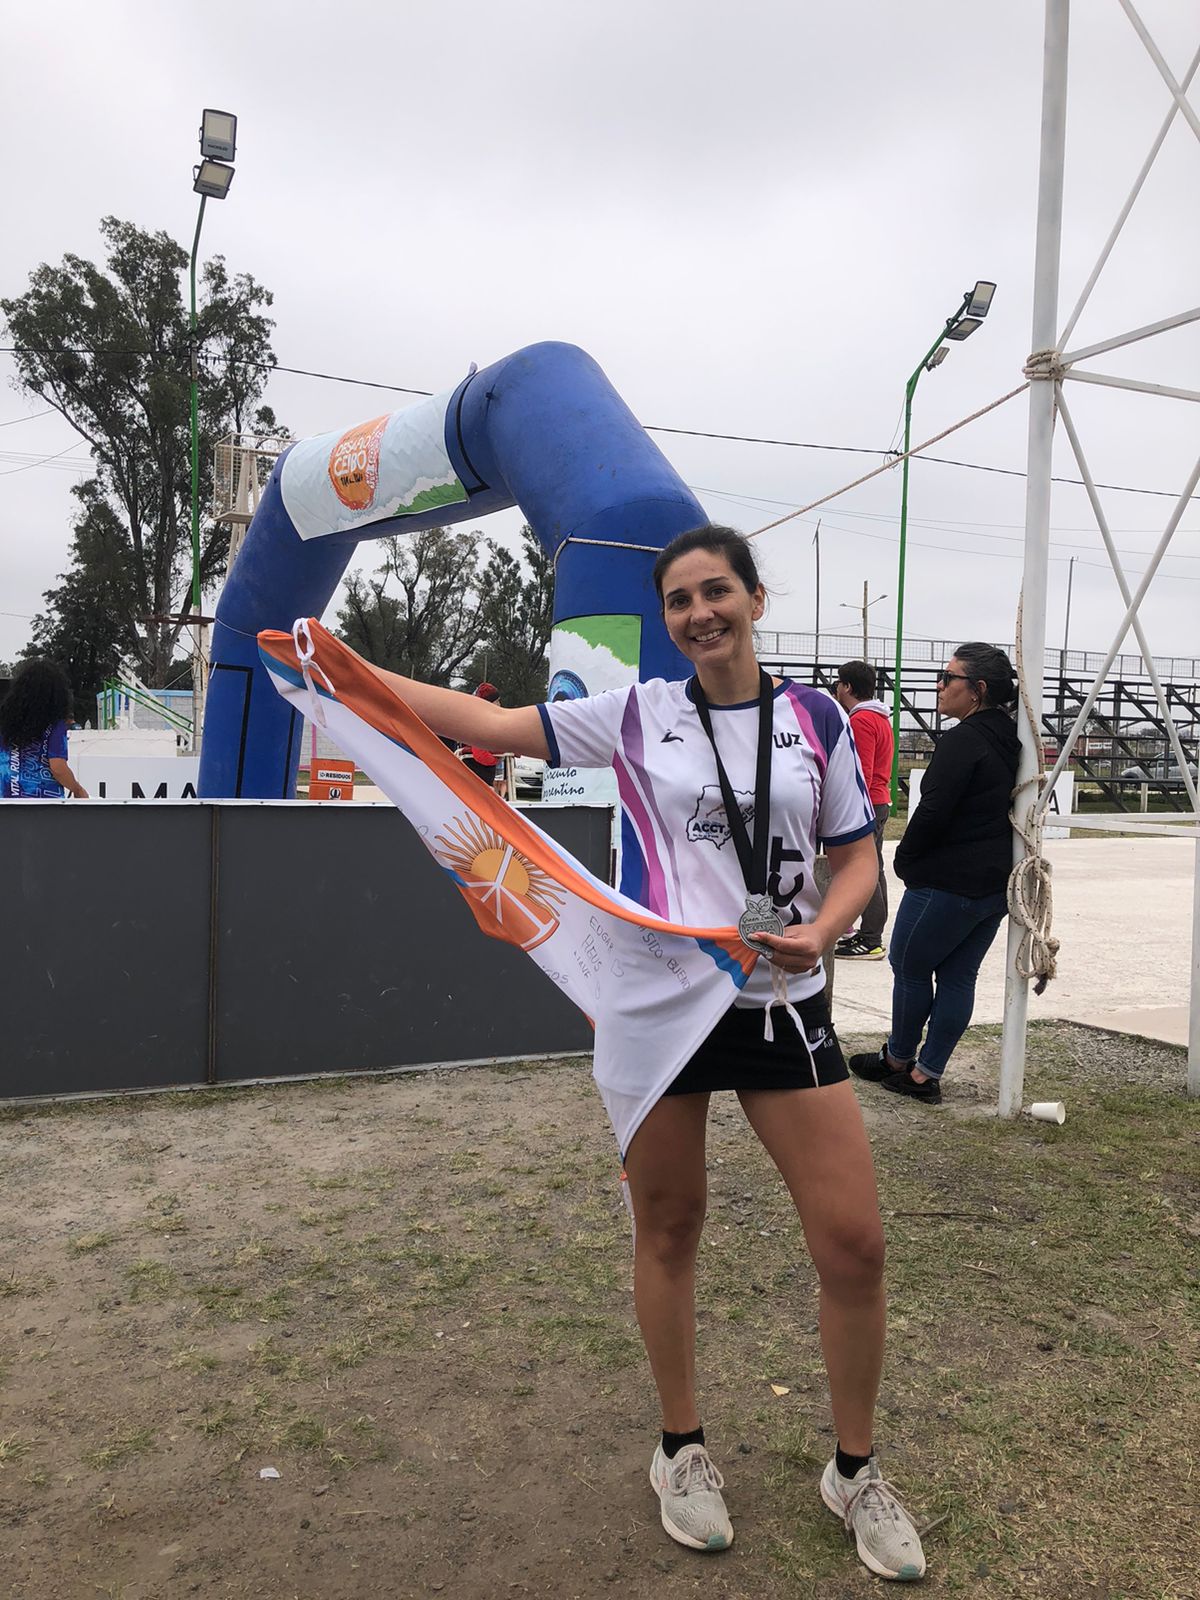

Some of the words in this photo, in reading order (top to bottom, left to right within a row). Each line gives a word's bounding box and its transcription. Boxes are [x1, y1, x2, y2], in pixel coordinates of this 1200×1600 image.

[334, 450, 367, 476] CEIBO
[773, 732, 803, 748] LUZ
[11, 775, 20, 796] VITAL
[692, 822, 725, 834] ACCT
[642, 932, 663, 959] SIDO
